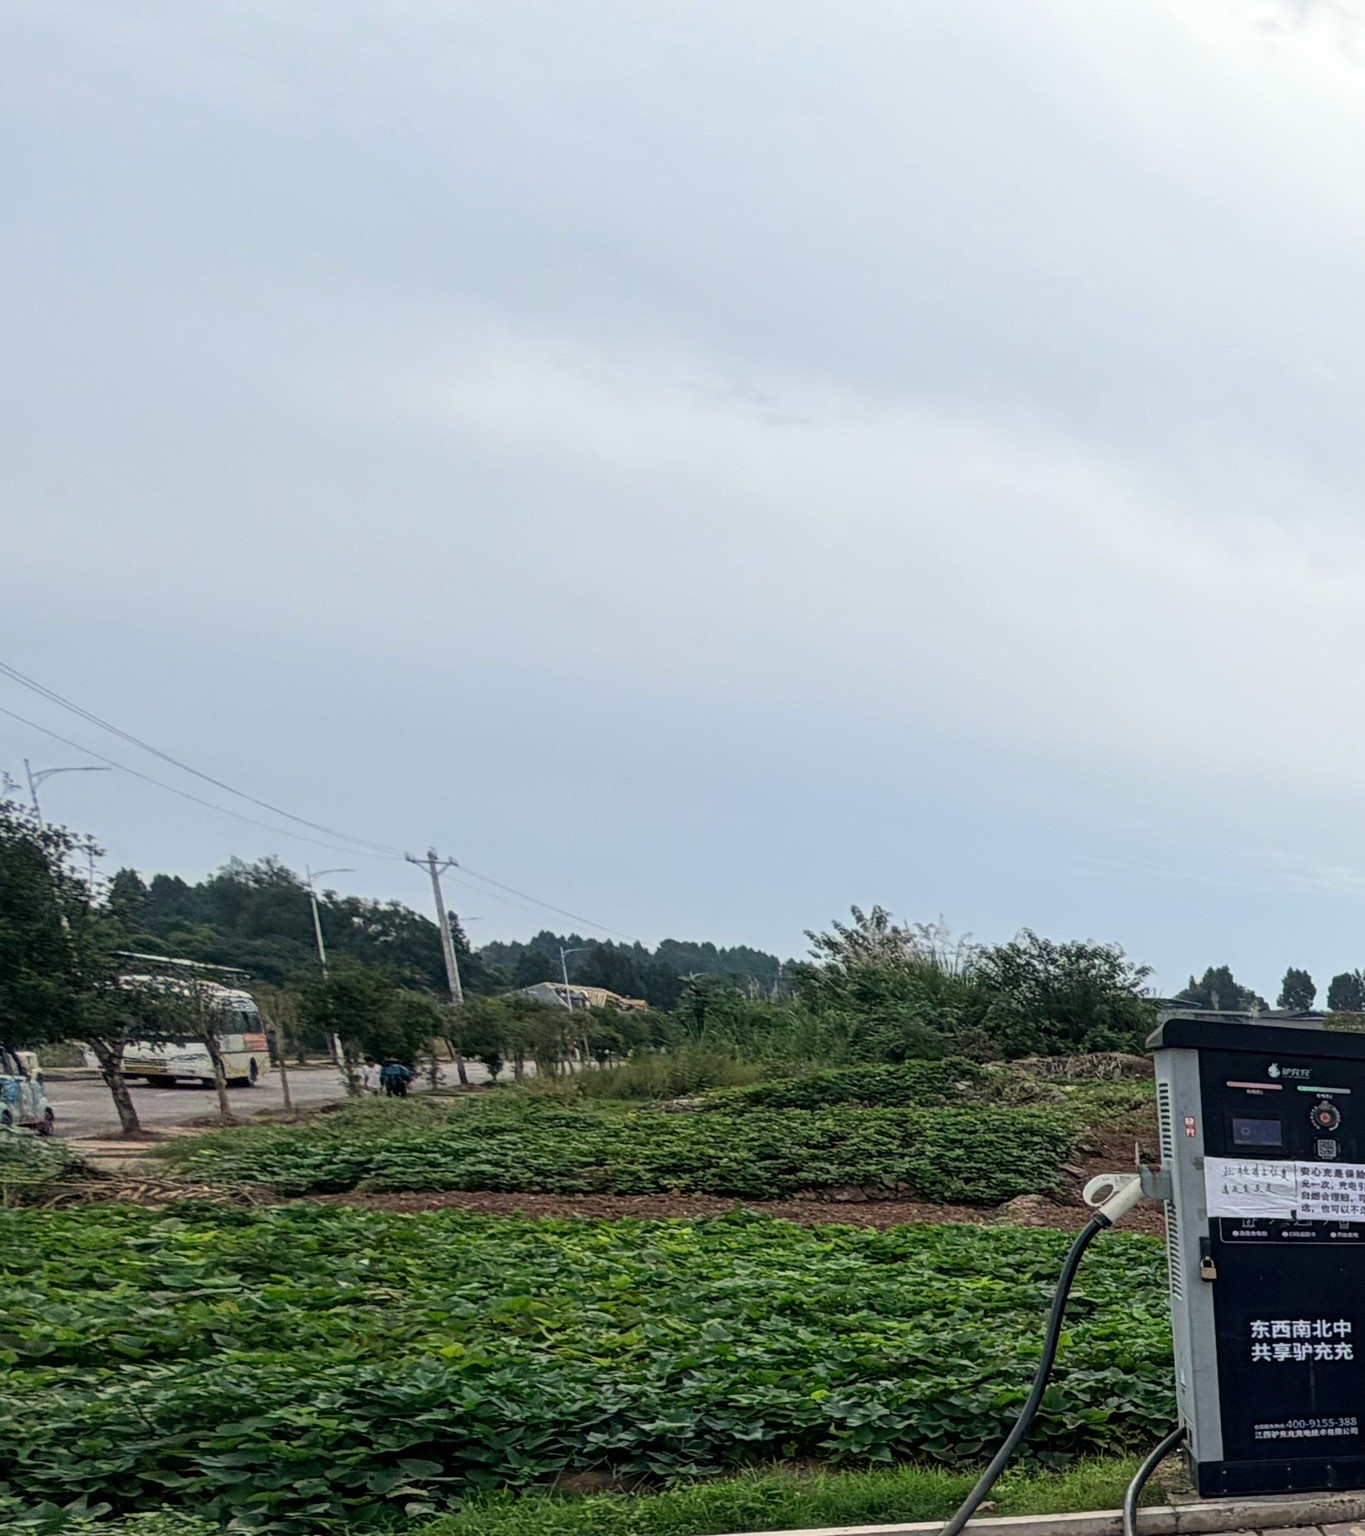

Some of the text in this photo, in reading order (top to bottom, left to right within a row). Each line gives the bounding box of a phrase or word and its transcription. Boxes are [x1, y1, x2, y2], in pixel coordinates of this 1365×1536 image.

[1250, 1319, 1352, 1339] 东西南北中
[1251, 1341, 1354, 1362] 共享驴充充
[1286, 1417, 1357, 1429] 400-9155-388
